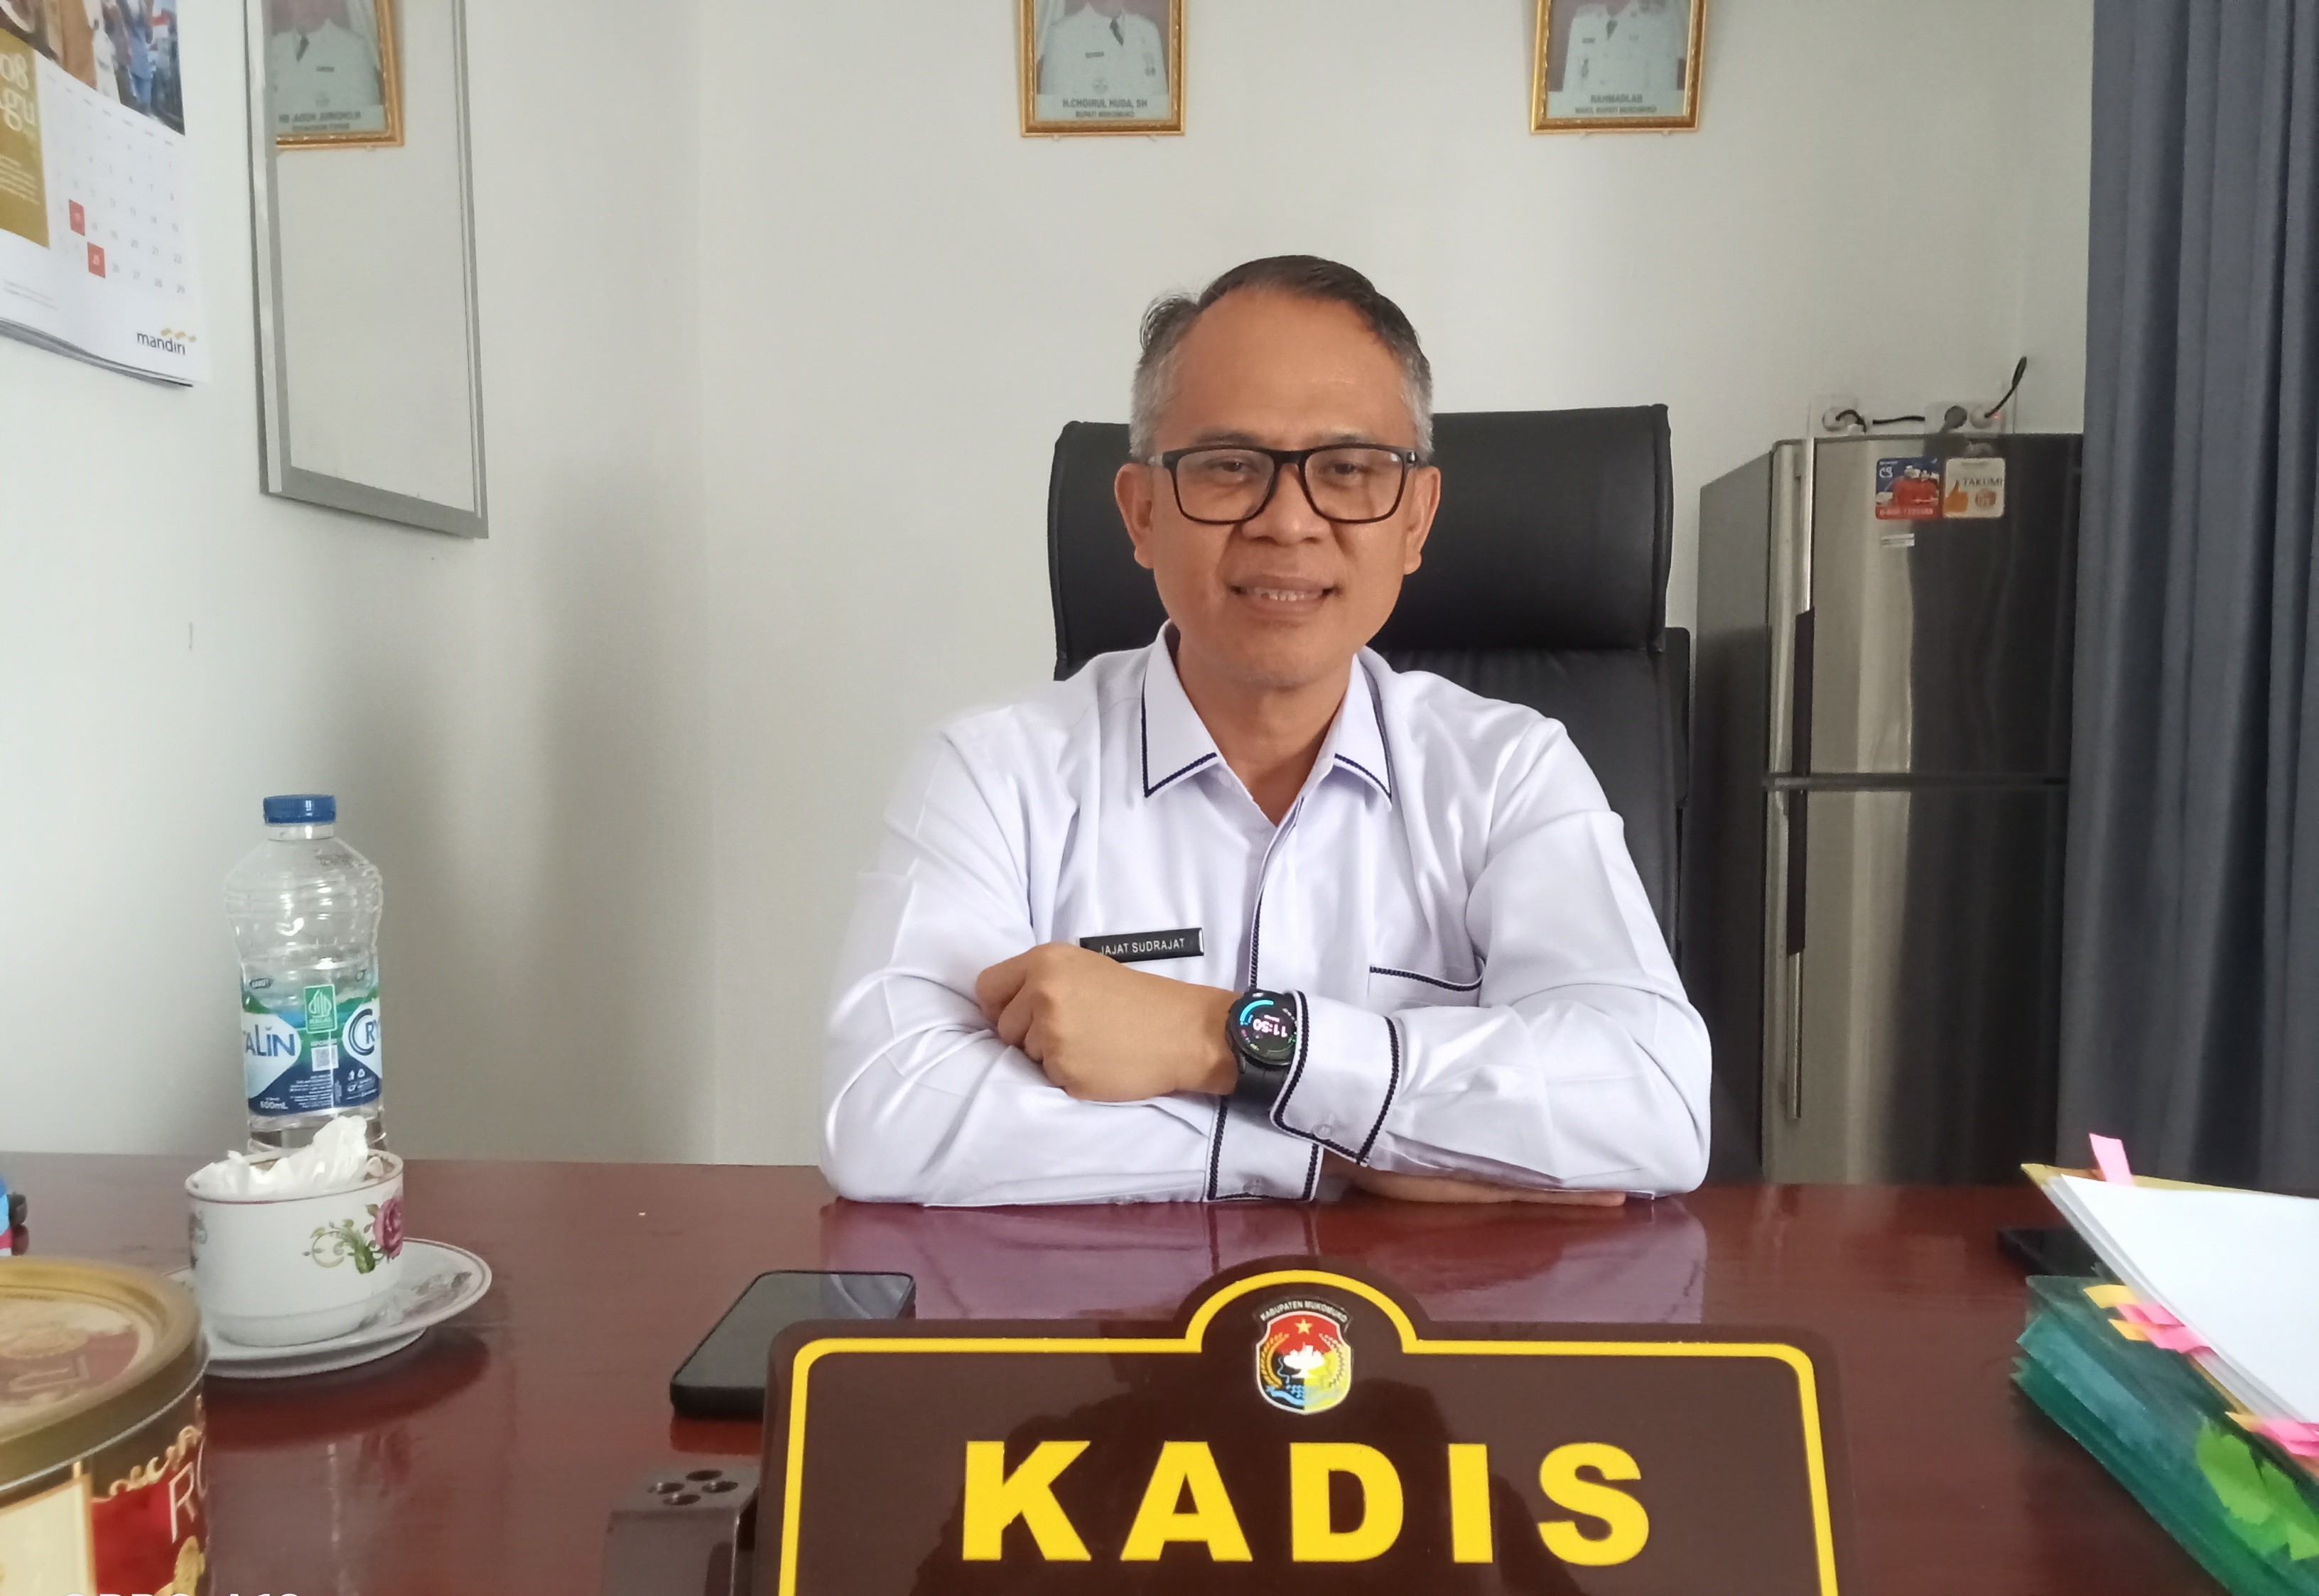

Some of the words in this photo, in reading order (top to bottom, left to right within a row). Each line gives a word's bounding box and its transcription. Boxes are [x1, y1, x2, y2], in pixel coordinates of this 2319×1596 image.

[0, 87, 36, 131] gu
[136, 331, 186, 356] mandiri
[1131, 937, 1186, 954] SUDRAJAT
[243, 1024, 296, 1057] ALIN
[1253, 1018, 1288, 1038] 11:50
[1260, 1301, 1304, 1321] KABUPATEN
[963, 1441, 1648, 1565] KADIS
